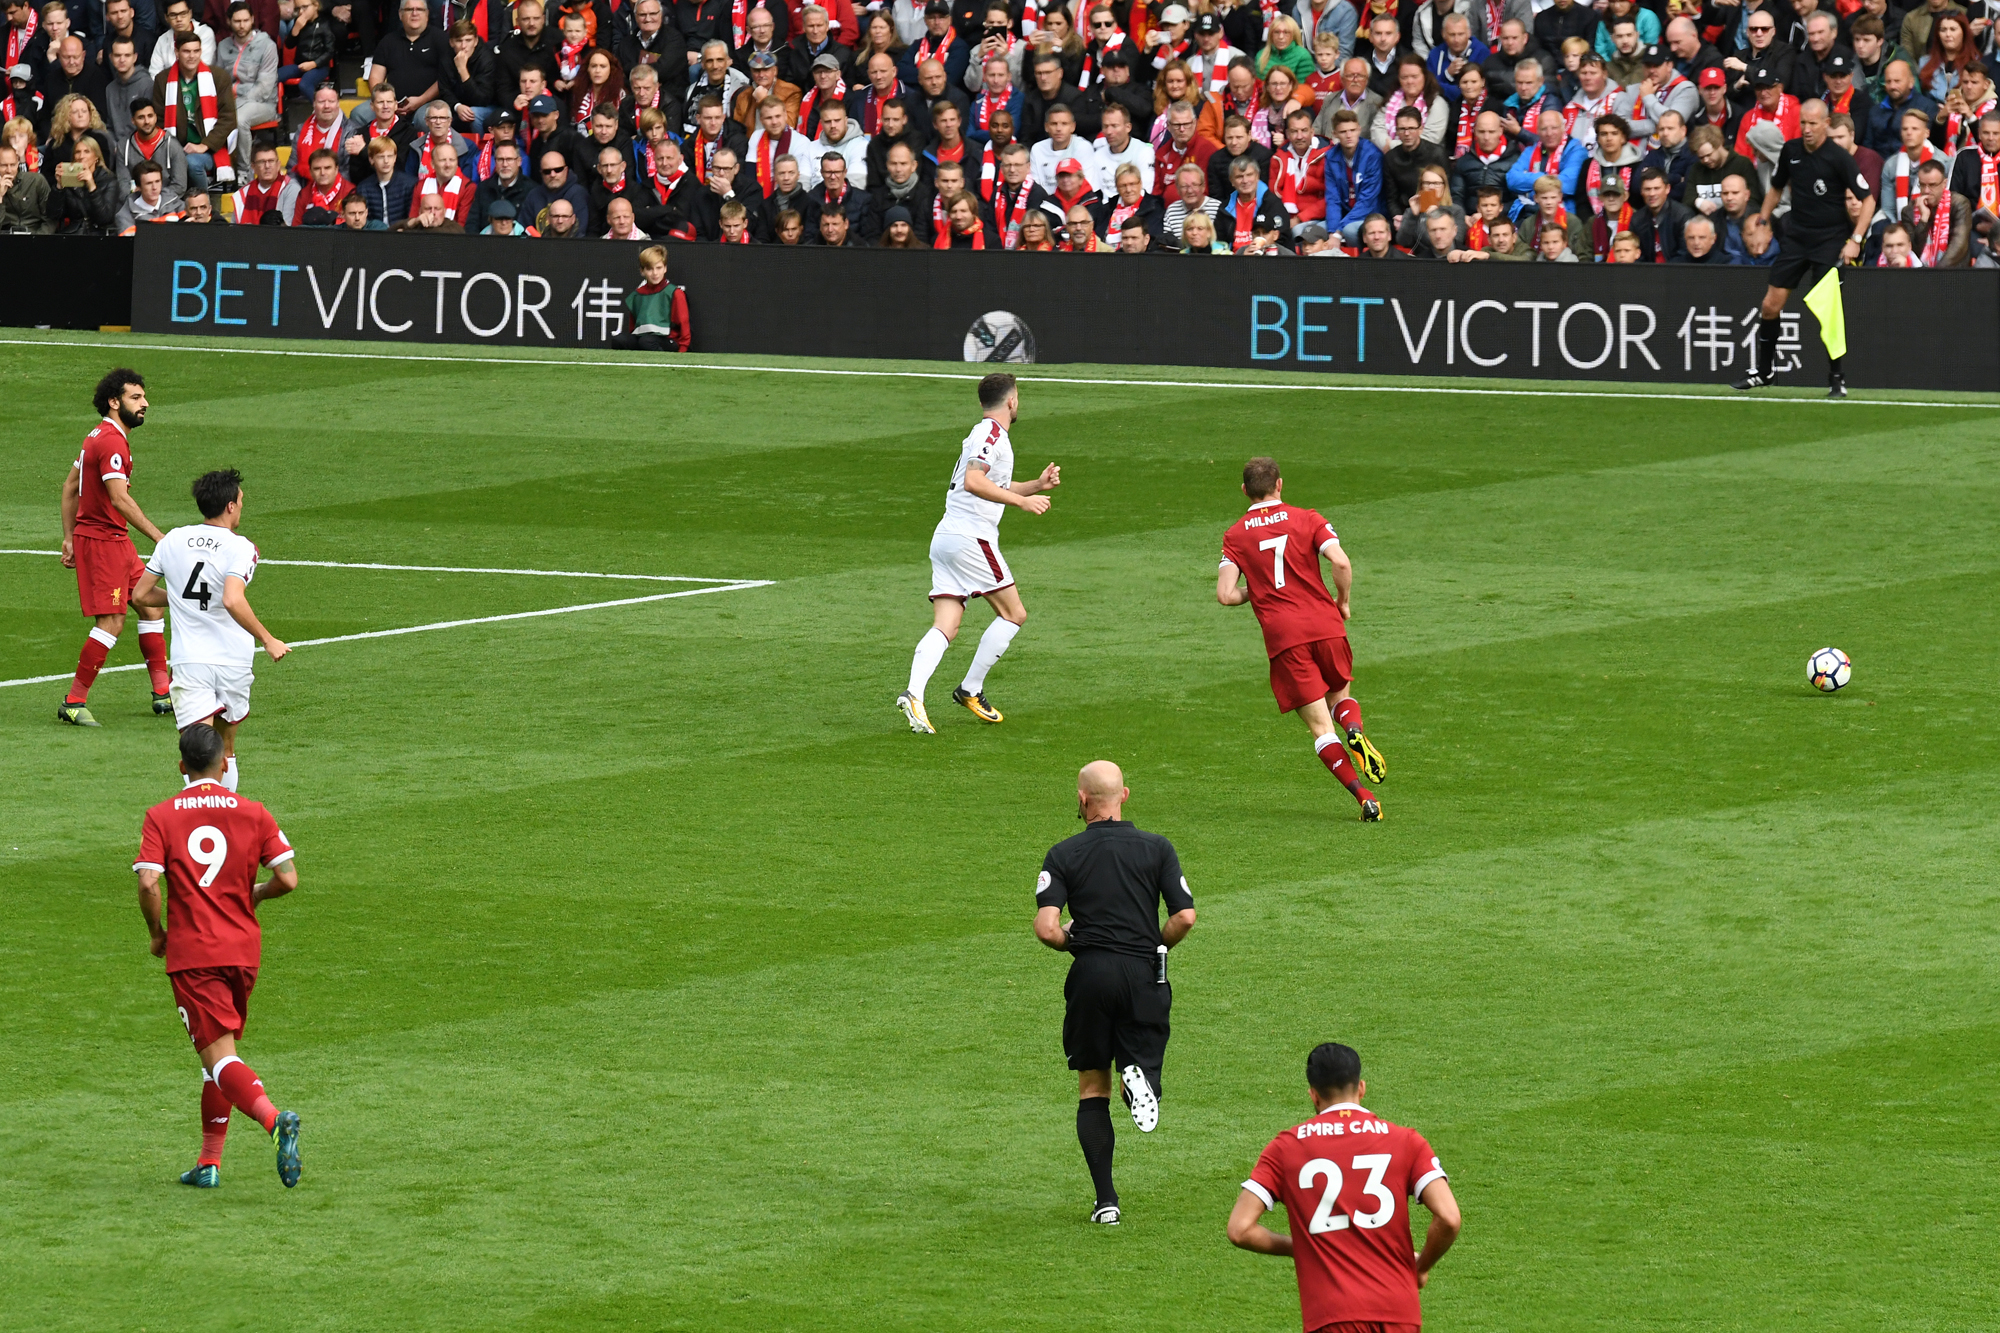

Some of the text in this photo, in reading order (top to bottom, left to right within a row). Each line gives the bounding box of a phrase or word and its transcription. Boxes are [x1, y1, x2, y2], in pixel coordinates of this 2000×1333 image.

[1244, 511, 1289, 531] MILNER
[187, 537, 222, 552] CORK
[1259, 533, 1288, 590] 7
[182, 561, 212, 611] 4
[174, 795, 239, 811] FIRMINO
[187, 825, 228, 888] 9
[1297, 1119, 1390, 1139] EMRE CAN
[1298, 1153, 1396, 1235] 23
